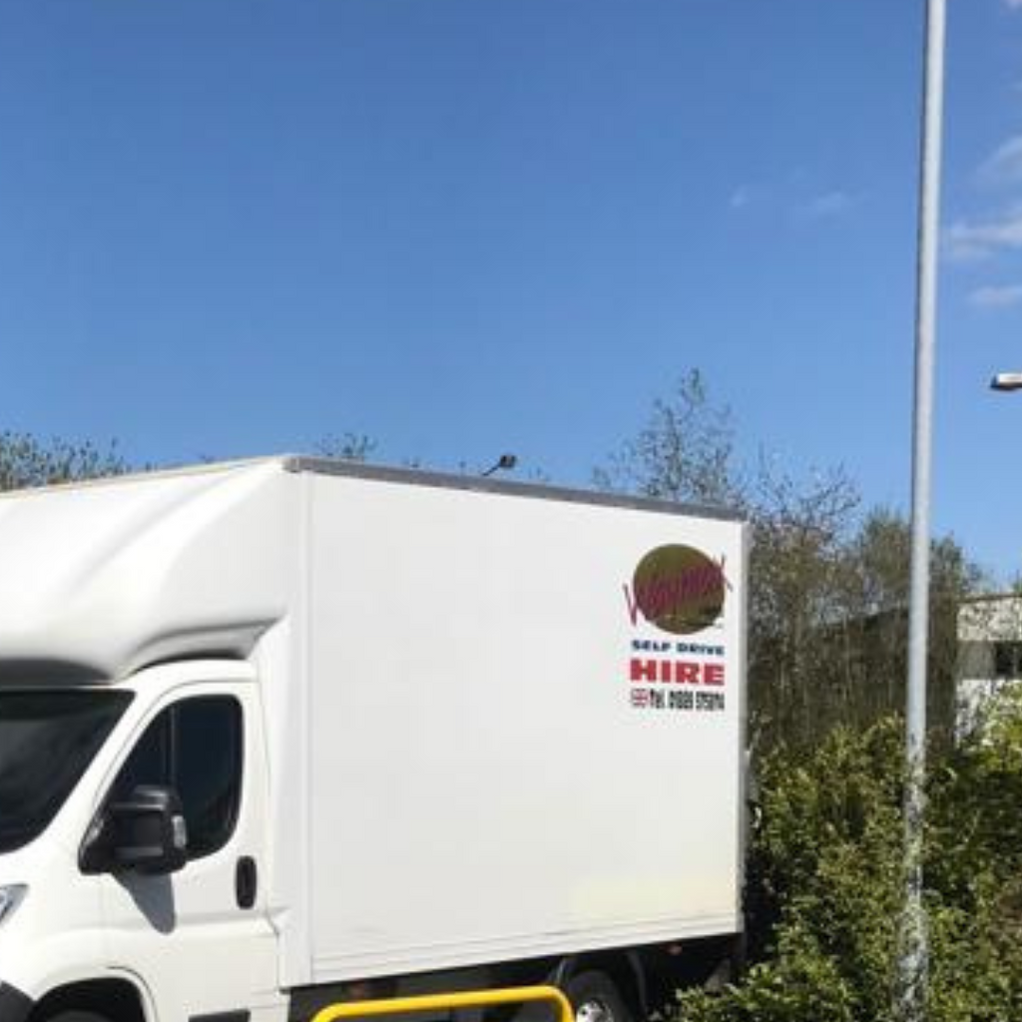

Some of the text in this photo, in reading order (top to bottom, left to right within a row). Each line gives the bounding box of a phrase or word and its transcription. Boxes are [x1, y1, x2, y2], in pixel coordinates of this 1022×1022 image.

[631, 639, 725, 656] SELF DRIVE
[630, 658, 725, 686] HIRE
